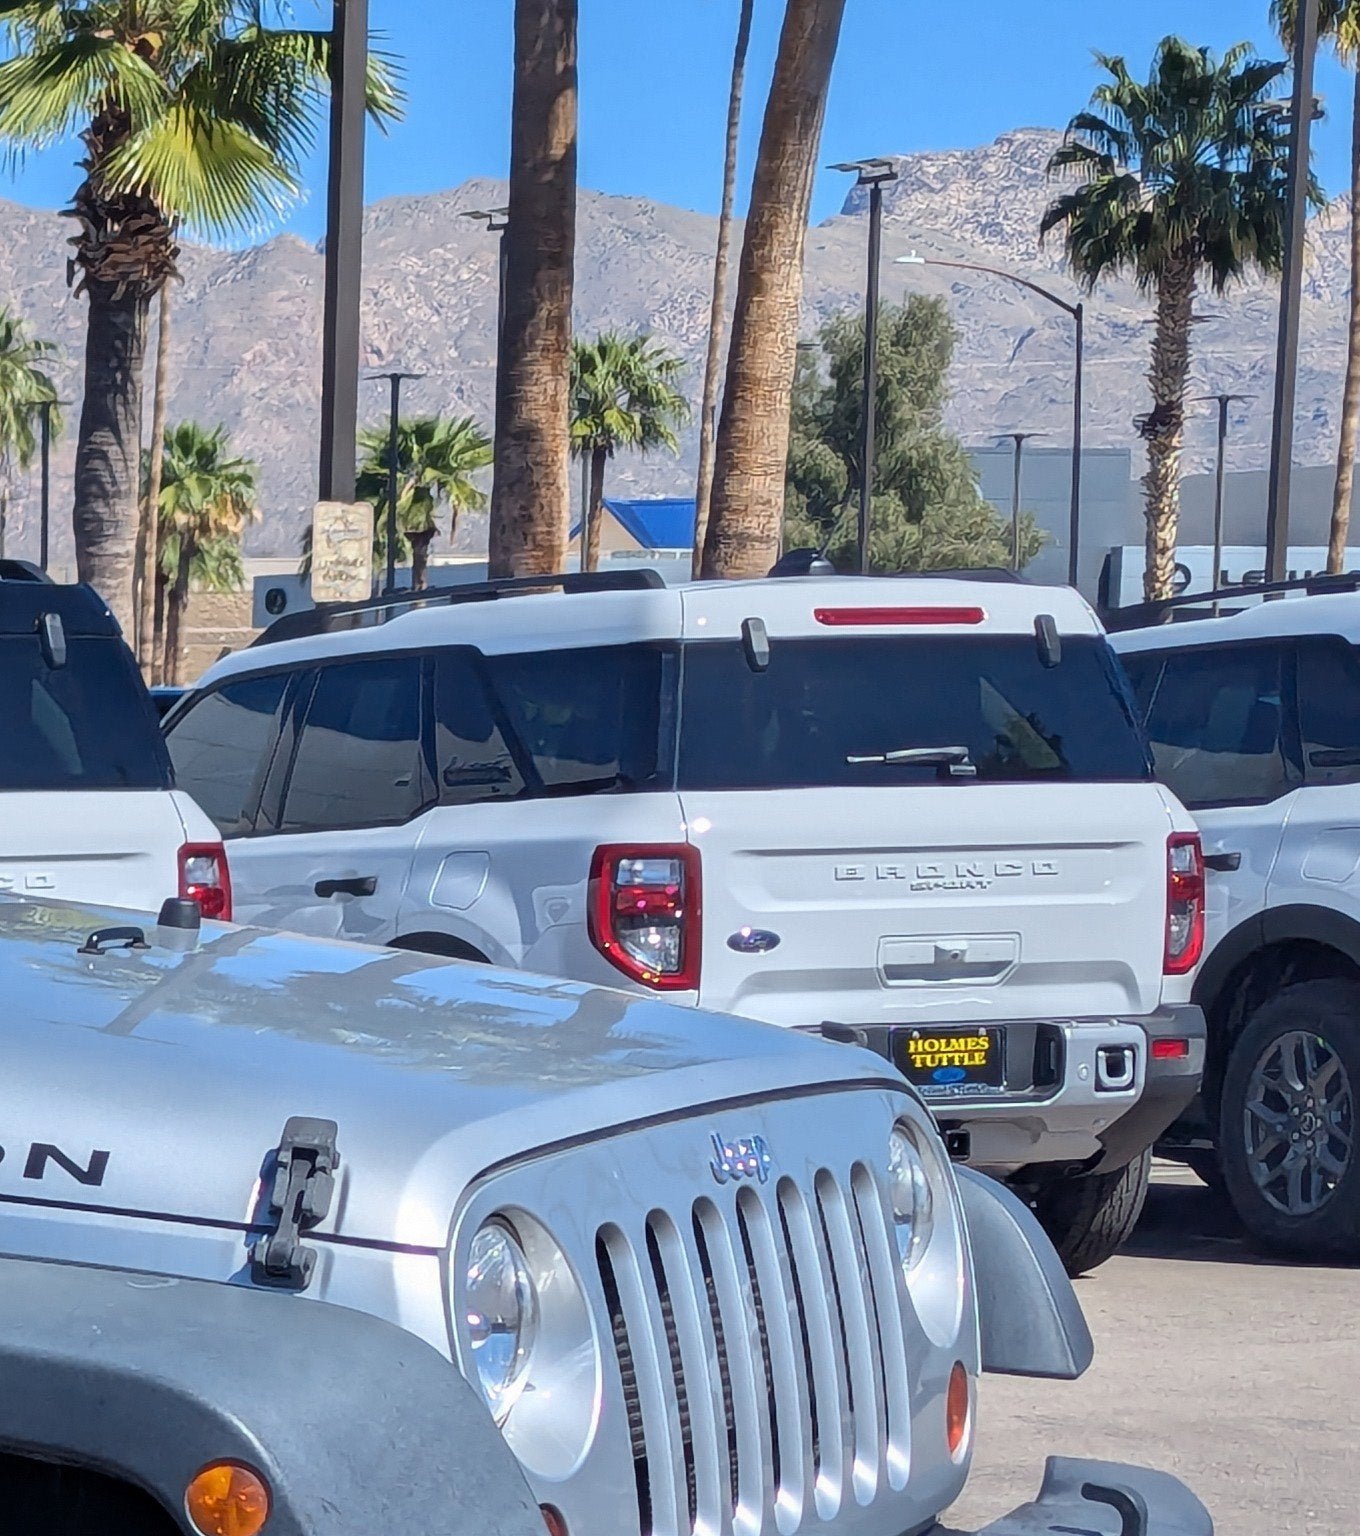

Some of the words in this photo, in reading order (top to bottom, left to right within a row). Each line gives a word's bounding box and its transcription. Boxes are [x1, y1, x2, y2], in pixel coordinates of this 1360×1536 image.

[834, 861, 1060, 881] BRONCO
[908, 1036, 989, 1054] HOLMES
[911, 1051, 986, 1068] TUTTLE
[709, 1132, 771, 1185] Jeep
